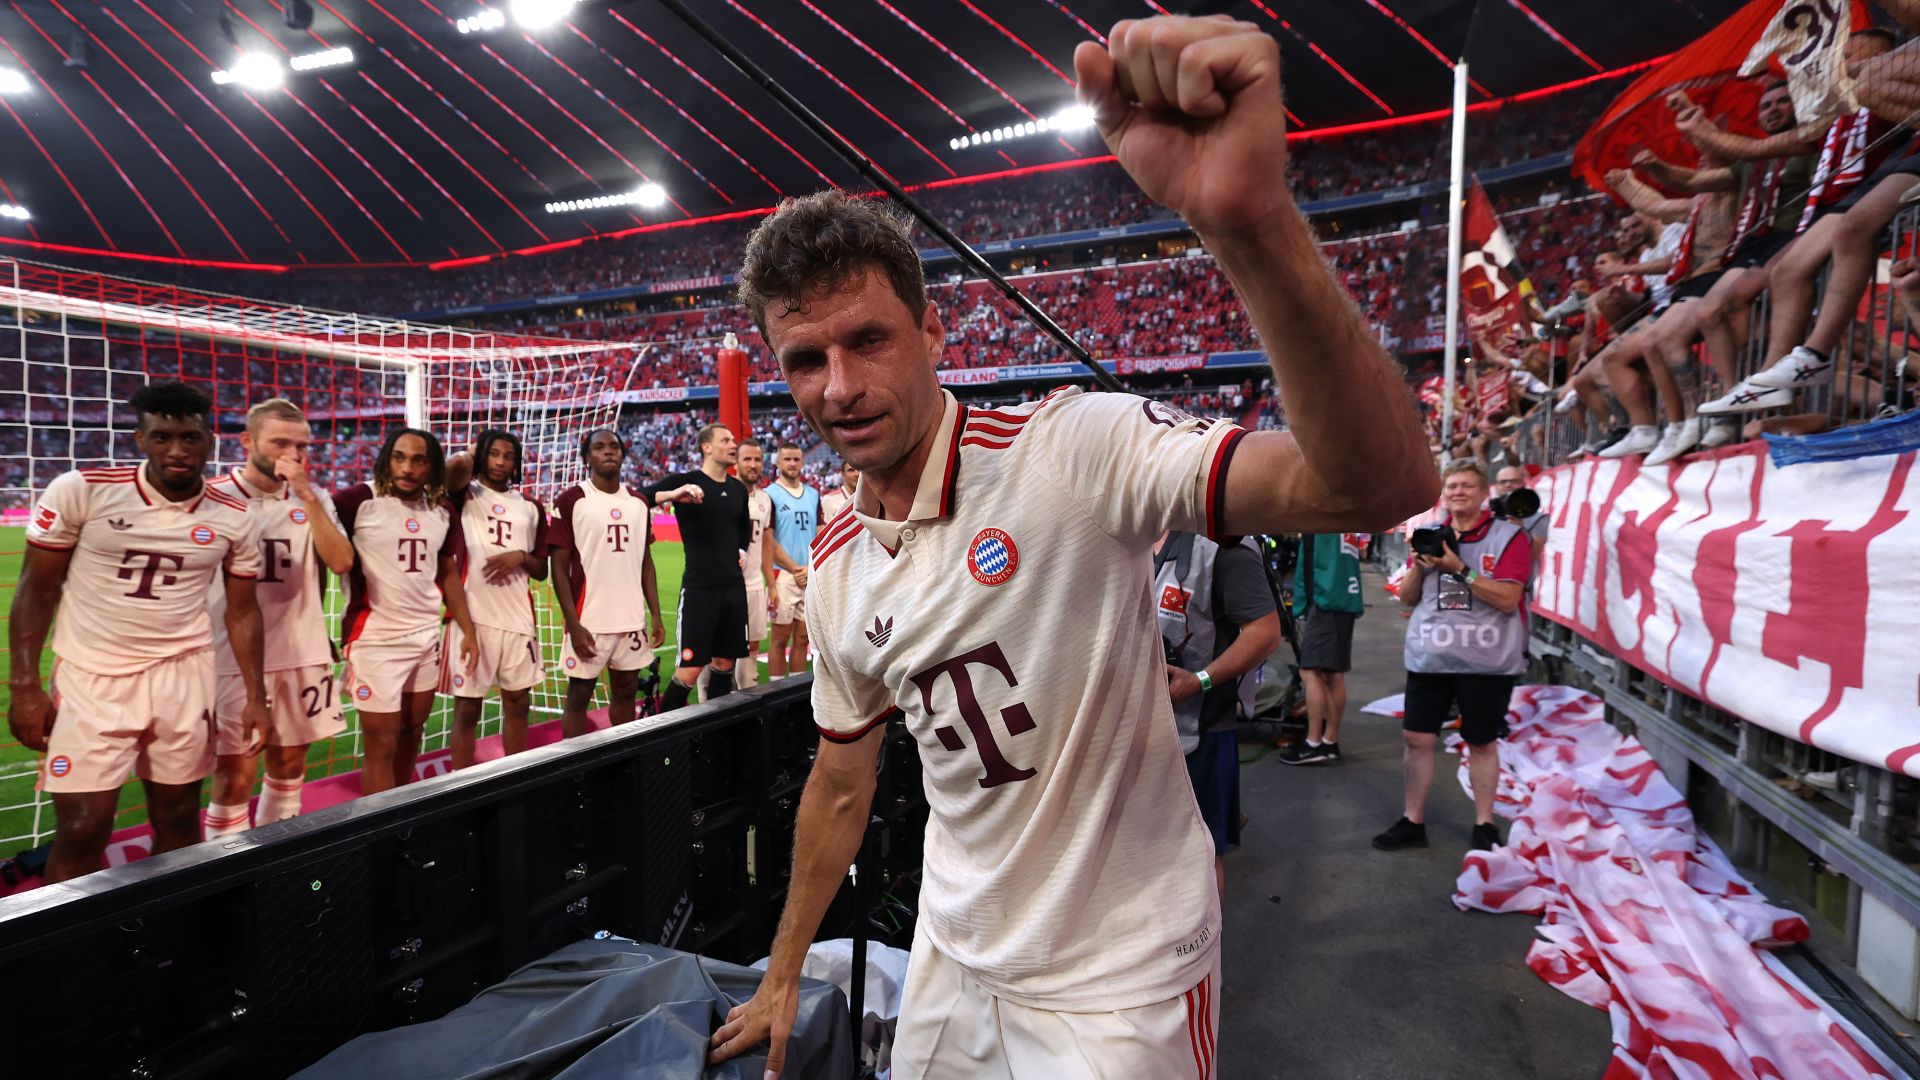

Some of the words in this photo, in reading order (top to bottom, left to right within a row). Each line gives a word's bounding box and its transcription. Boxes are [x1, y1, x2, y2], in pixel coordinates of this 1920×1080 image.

[1016, 368, 1040, 376] Global
[1040, 366, 1072, 375] Investors
[488, 516, 512, 547] T
[795, 512, 809, 531] T
[978, 530, 1006, 541] BAYERN
[607, 524, 629, 552] T
[397, 538, 428, 573] T
[117, 549, 183, 600] T
[974, 568, 1012, 583] MÜNCHEN
[1348, 576, 1360, 594] 2
[1419, 623, 1500, 648] FOTO
[301, 674, 334, 718] 27
[909, 640, 1038, 789] T
[1175, 925, 1211, 957] HEAT.RDY
